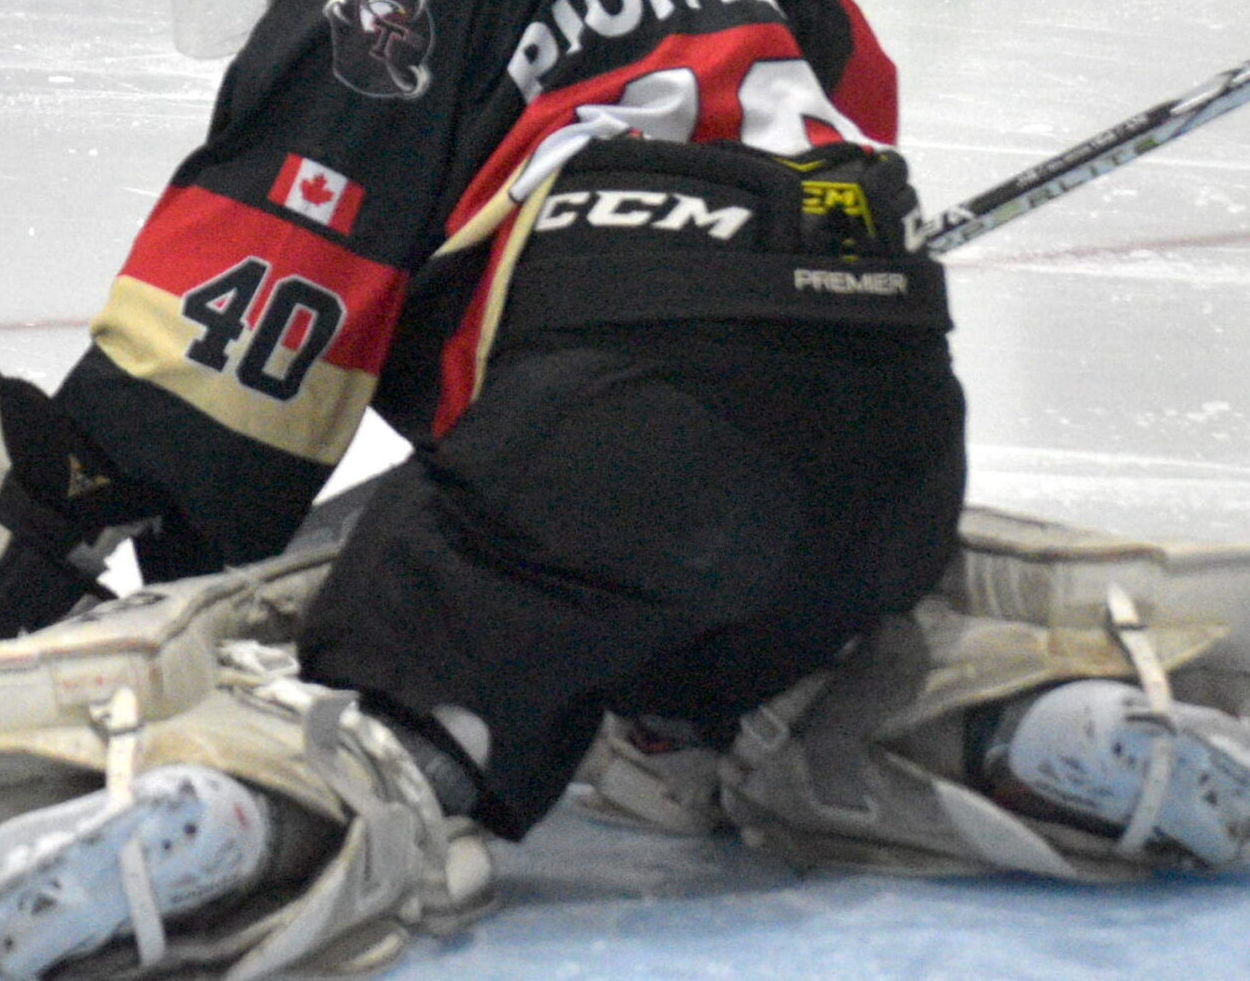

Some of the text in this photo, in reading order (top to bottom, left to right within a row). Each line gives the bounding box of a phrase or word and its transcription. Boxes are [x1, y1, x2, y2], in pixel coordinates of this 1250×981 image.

[533, 190, 752, 240] CCM
[793, 269, 907, 296] PREMIER
[181, 255, 347, 402] 40
